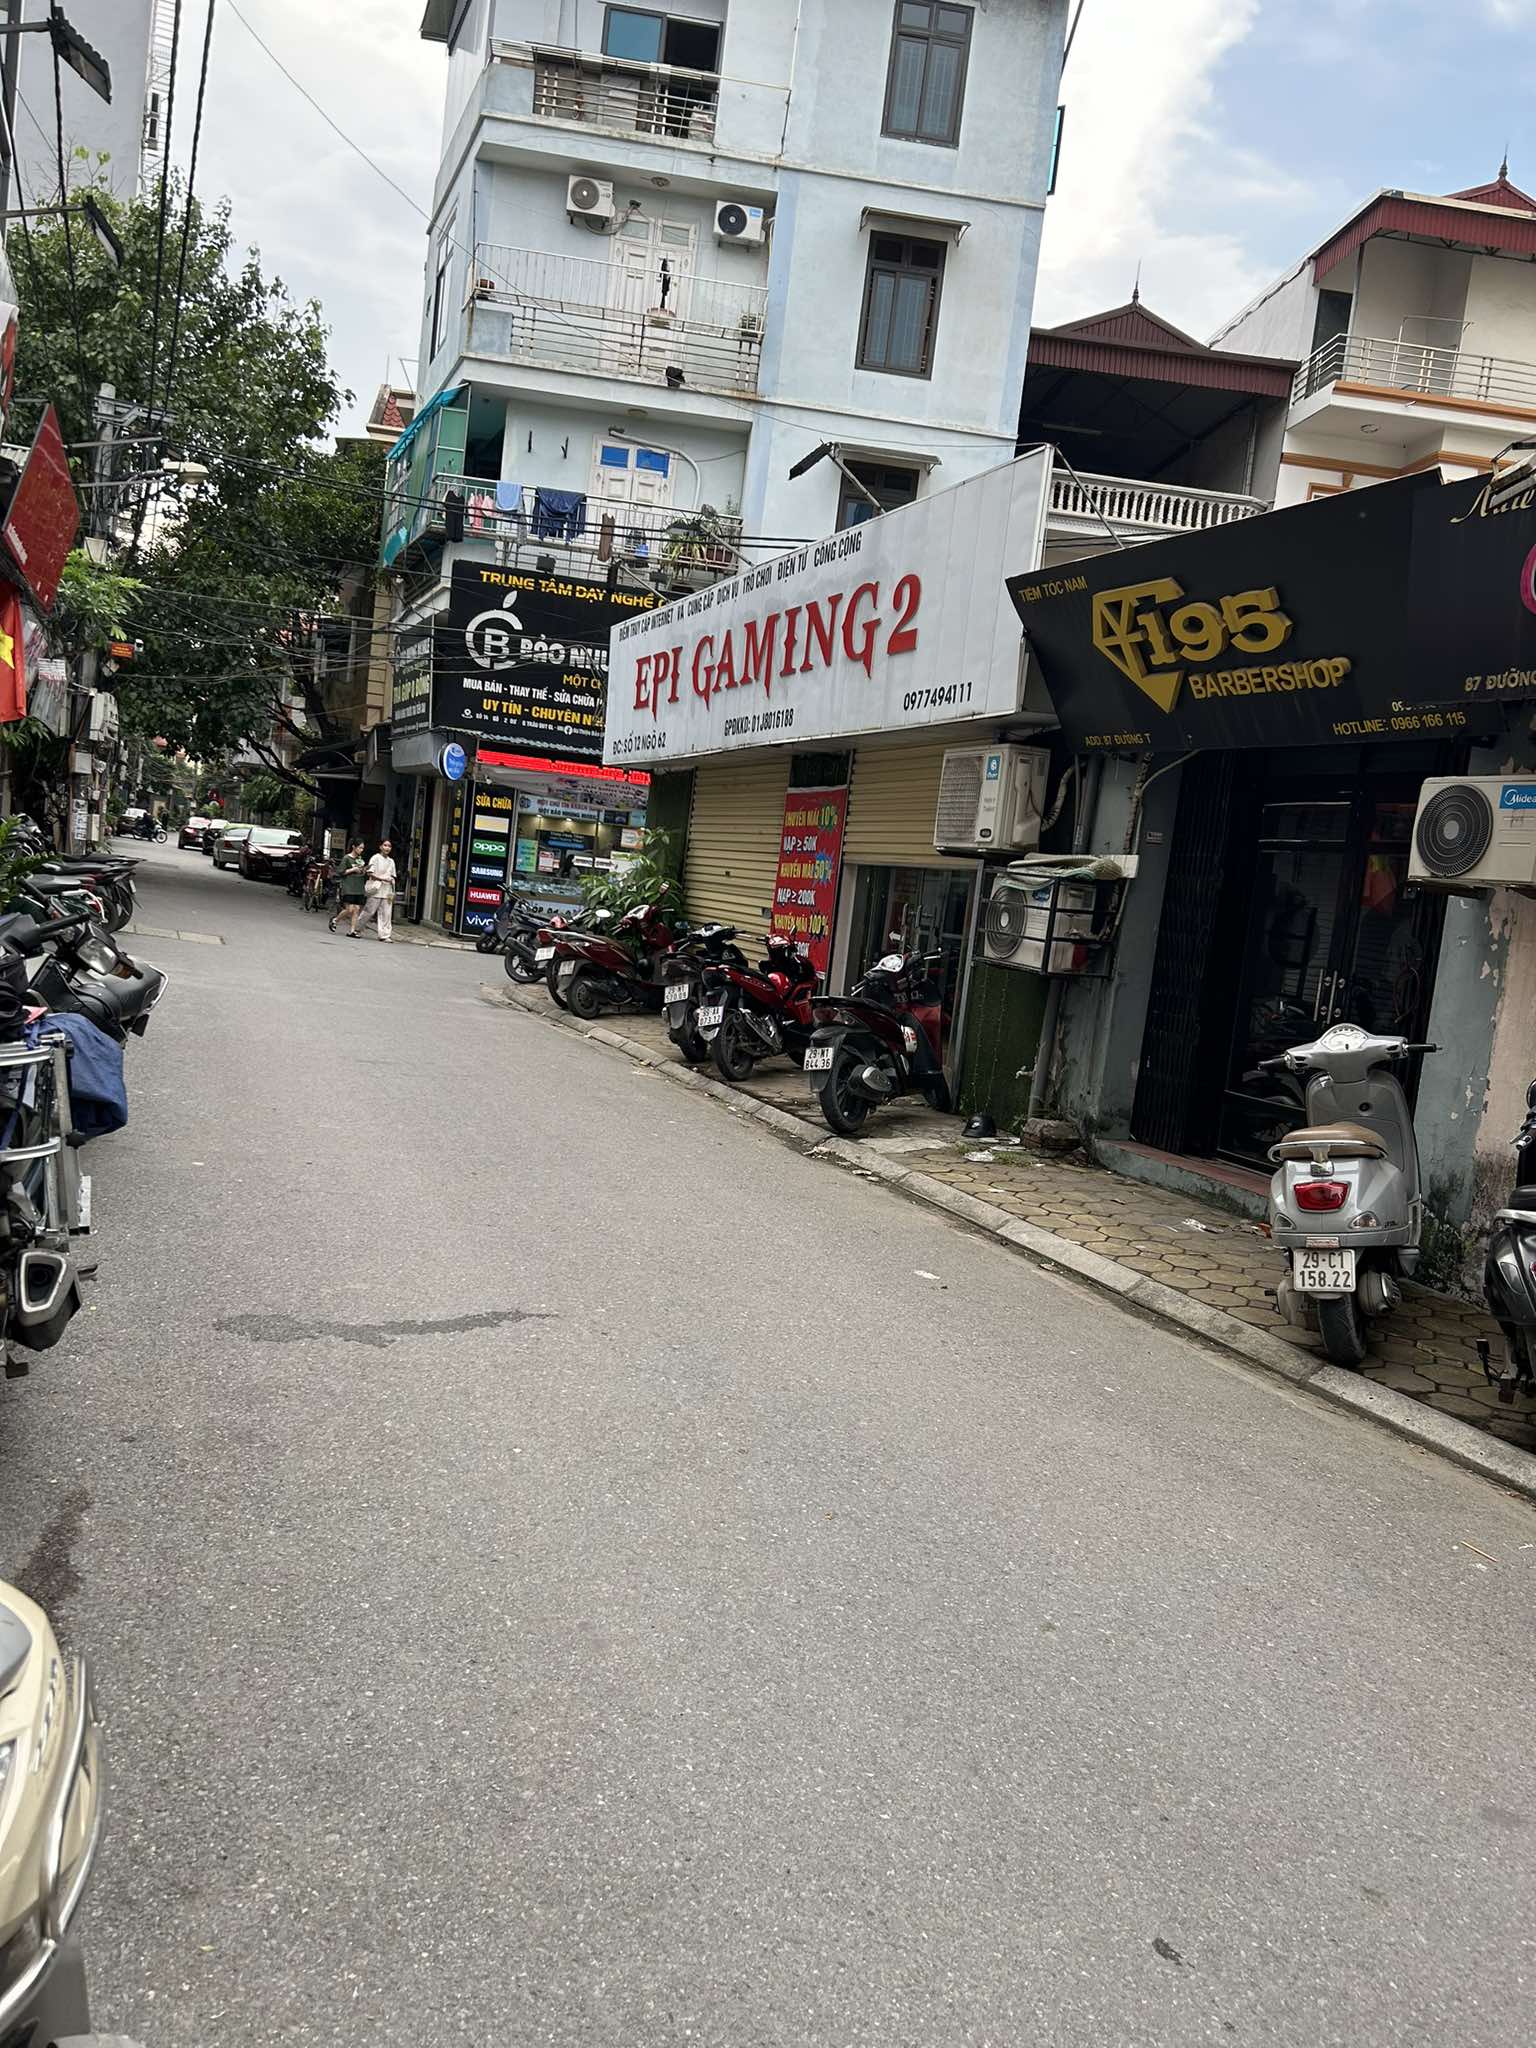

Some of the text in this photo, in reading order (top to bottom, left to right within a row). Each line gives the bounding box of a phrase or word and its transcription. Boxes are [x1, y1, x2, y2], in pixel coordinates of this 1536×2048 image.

[813, 539, 837, 568] CÔNG
[838, 530, 863, 562] CỘNG
[480, 570, 535, 591] TRUNG
[539, 578, 573, 597] TÂM
[575, 586, 607, 603] DẠY
[1064, 576, 1088, 593] NAM
[633, 646, 683, 721] EPI
[691, 581, 882, 711] GAMING
[562, 673, 589, 688] MỘT
[1187, 656, 1350, 700] BARBERSHOP
[1465, 675, 1482, 692] 87
[463, 677, 482, 691] MUA
[484, 680, 502, 693] BÁN
[509, 685, 530, 698] THAY
[532, 685, 548, 700] THẾ
[553, 688, 571, 704] SỬA
[904, 682, 973, 711] 0977494111
[482, 698, 499, 711] UY
[502, 700, 522, 715] TÍN
[531, 706, 580, 724] CHUYÊN
[1333, 710, 1466, 736] HOTLINE: 0966 166 115
[658, 731, 666, 748] 62
[820, 806, 839, 827] 10%
[803, 835, 818, 852] 50K
[471, 866, 504, 878] SAMSUNG
[815, 859, 832, 880] 50%
[469, 891, 500, 902] HUAWEI
[798, 890, 816, 906] 200K
[808, 914, 830, 937] 100%
[1303, 1252, 1344, 1269] 29-C1
[1300, 1270, 1351, 1288] 158.22
